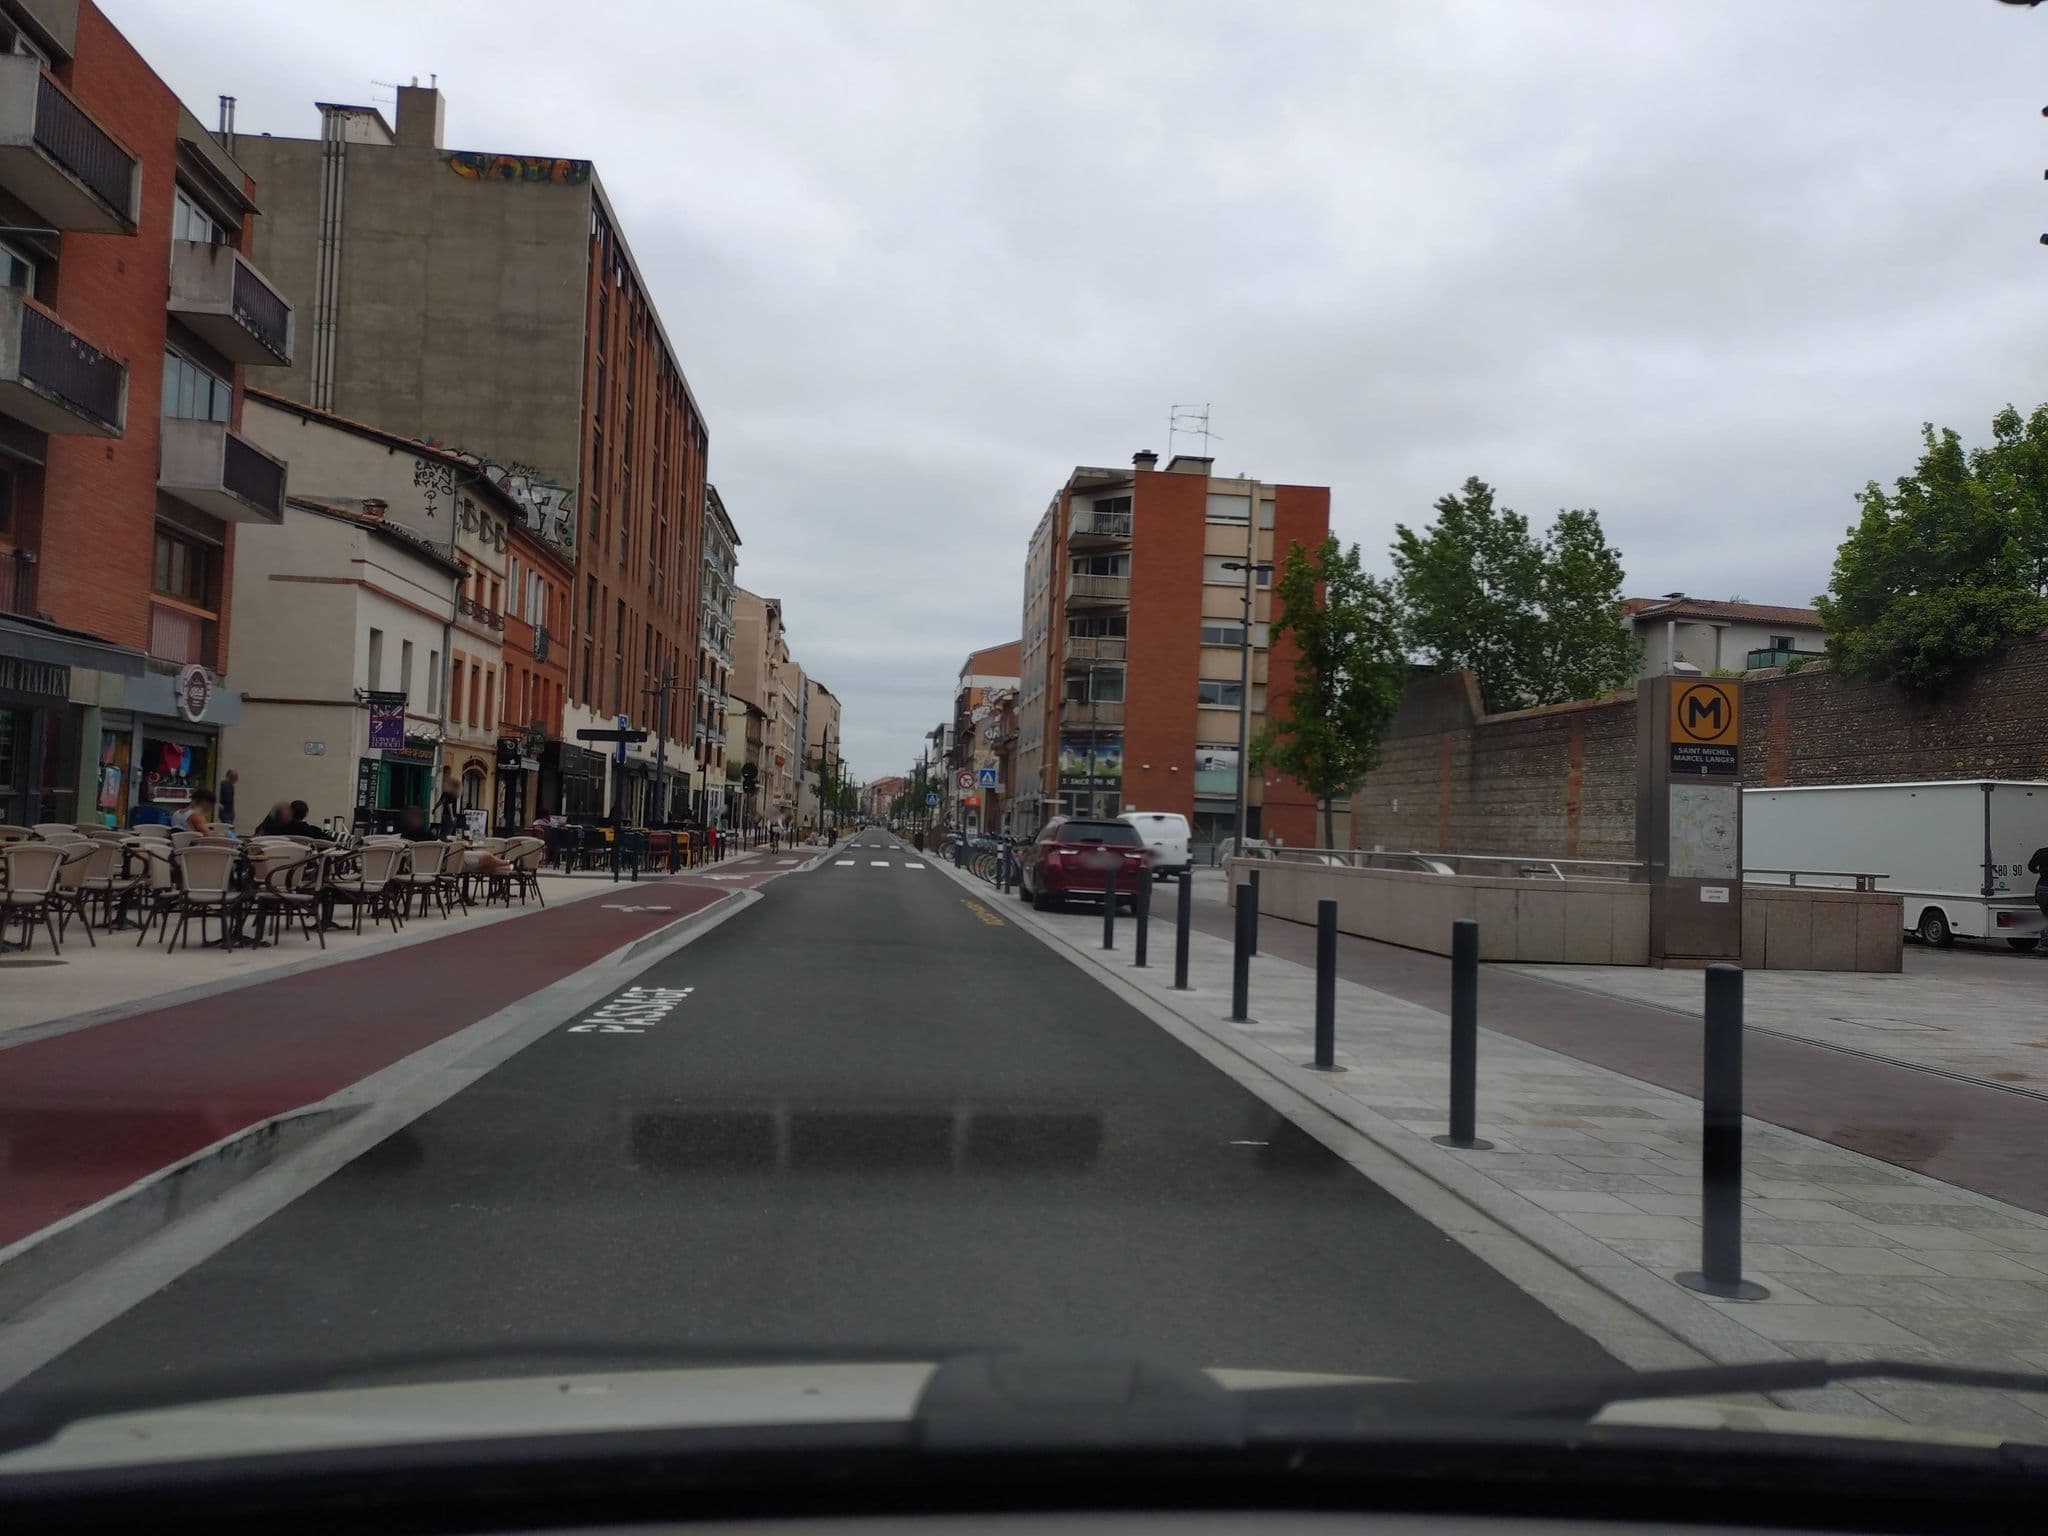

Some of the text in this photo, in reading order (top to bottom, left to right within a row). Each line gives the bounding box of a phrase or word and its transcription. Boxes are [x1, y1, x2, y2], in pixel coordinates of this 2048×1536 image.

[22, 664, 67, 696] ITALIEN
[1688, 696, 1721, 729] M
[1678, 747, 1731, 756] SAINT MICHEL
[1705, 756, 1736, 764] LANGER
[1701, 765, 1708, 774] B
[1998, 864, 2023, 877] 80 90
[567, 986, 696, 1033] PASSAGE
